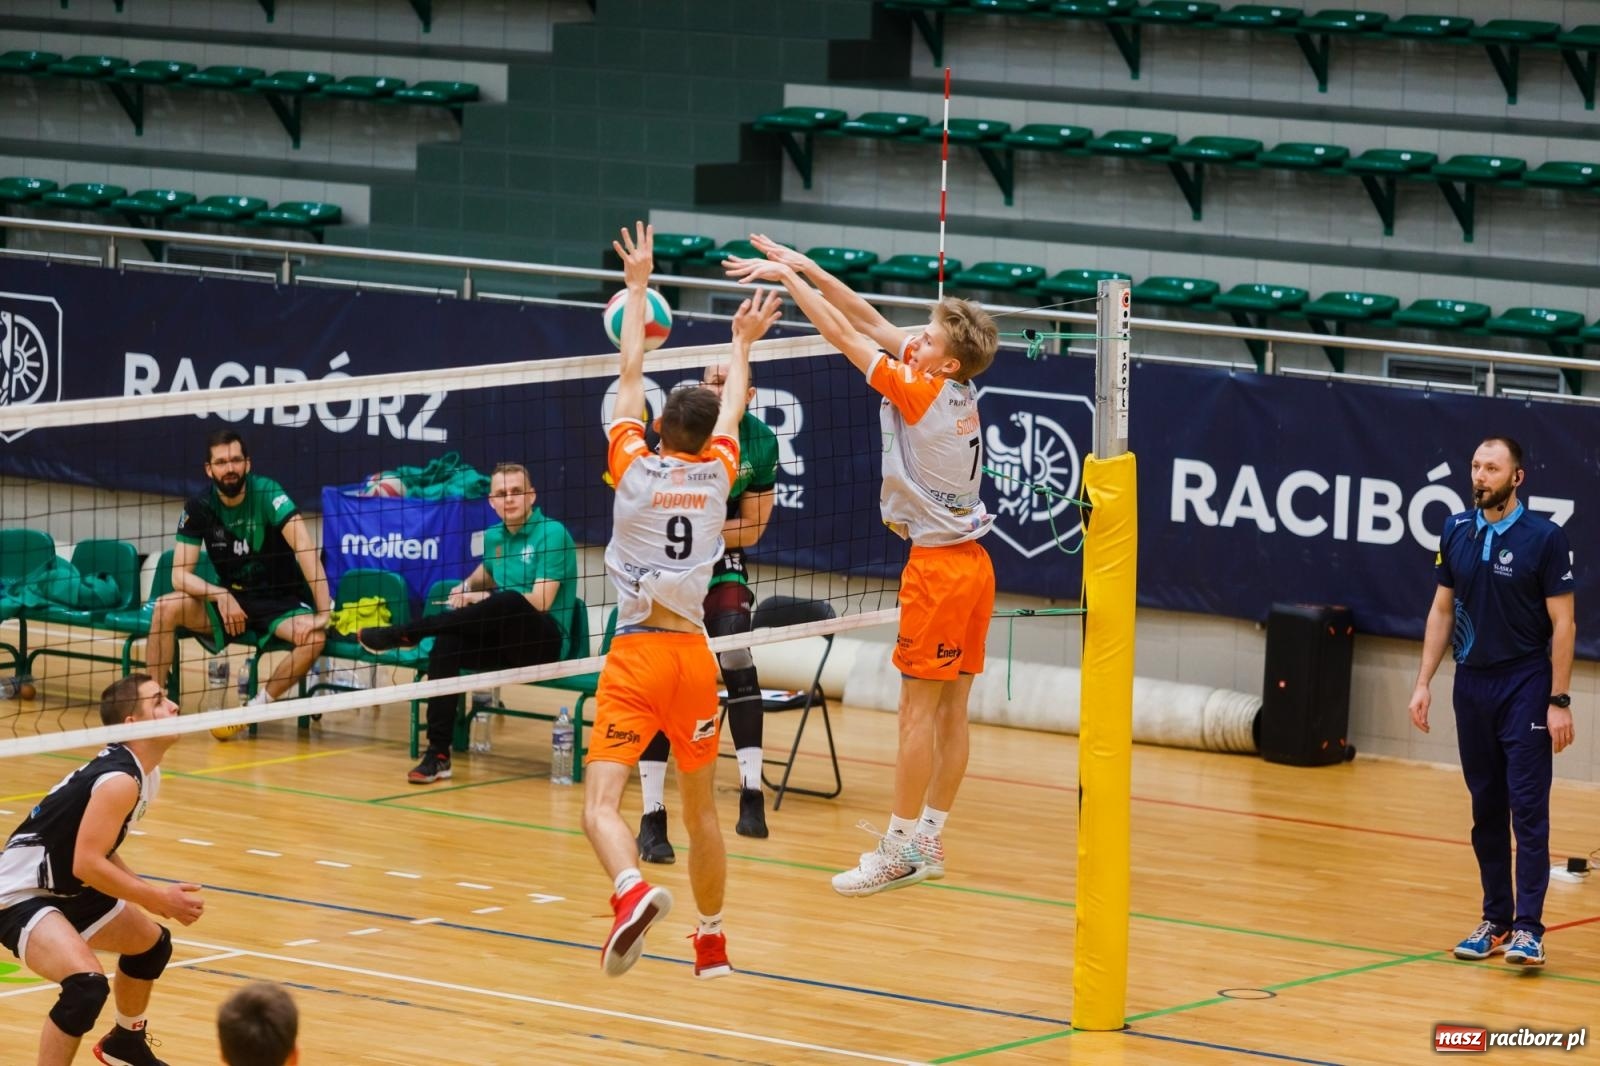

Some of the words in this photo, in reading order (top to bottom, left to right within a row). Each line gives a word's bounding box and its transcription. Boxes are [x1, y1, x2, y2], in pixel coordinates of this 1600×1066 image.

[969, 437, 980, 481] 7
[653, 491, 708, 510] POPOW
[341, 532, 439, 560] molten
[664, 515, 693, 560] 9
